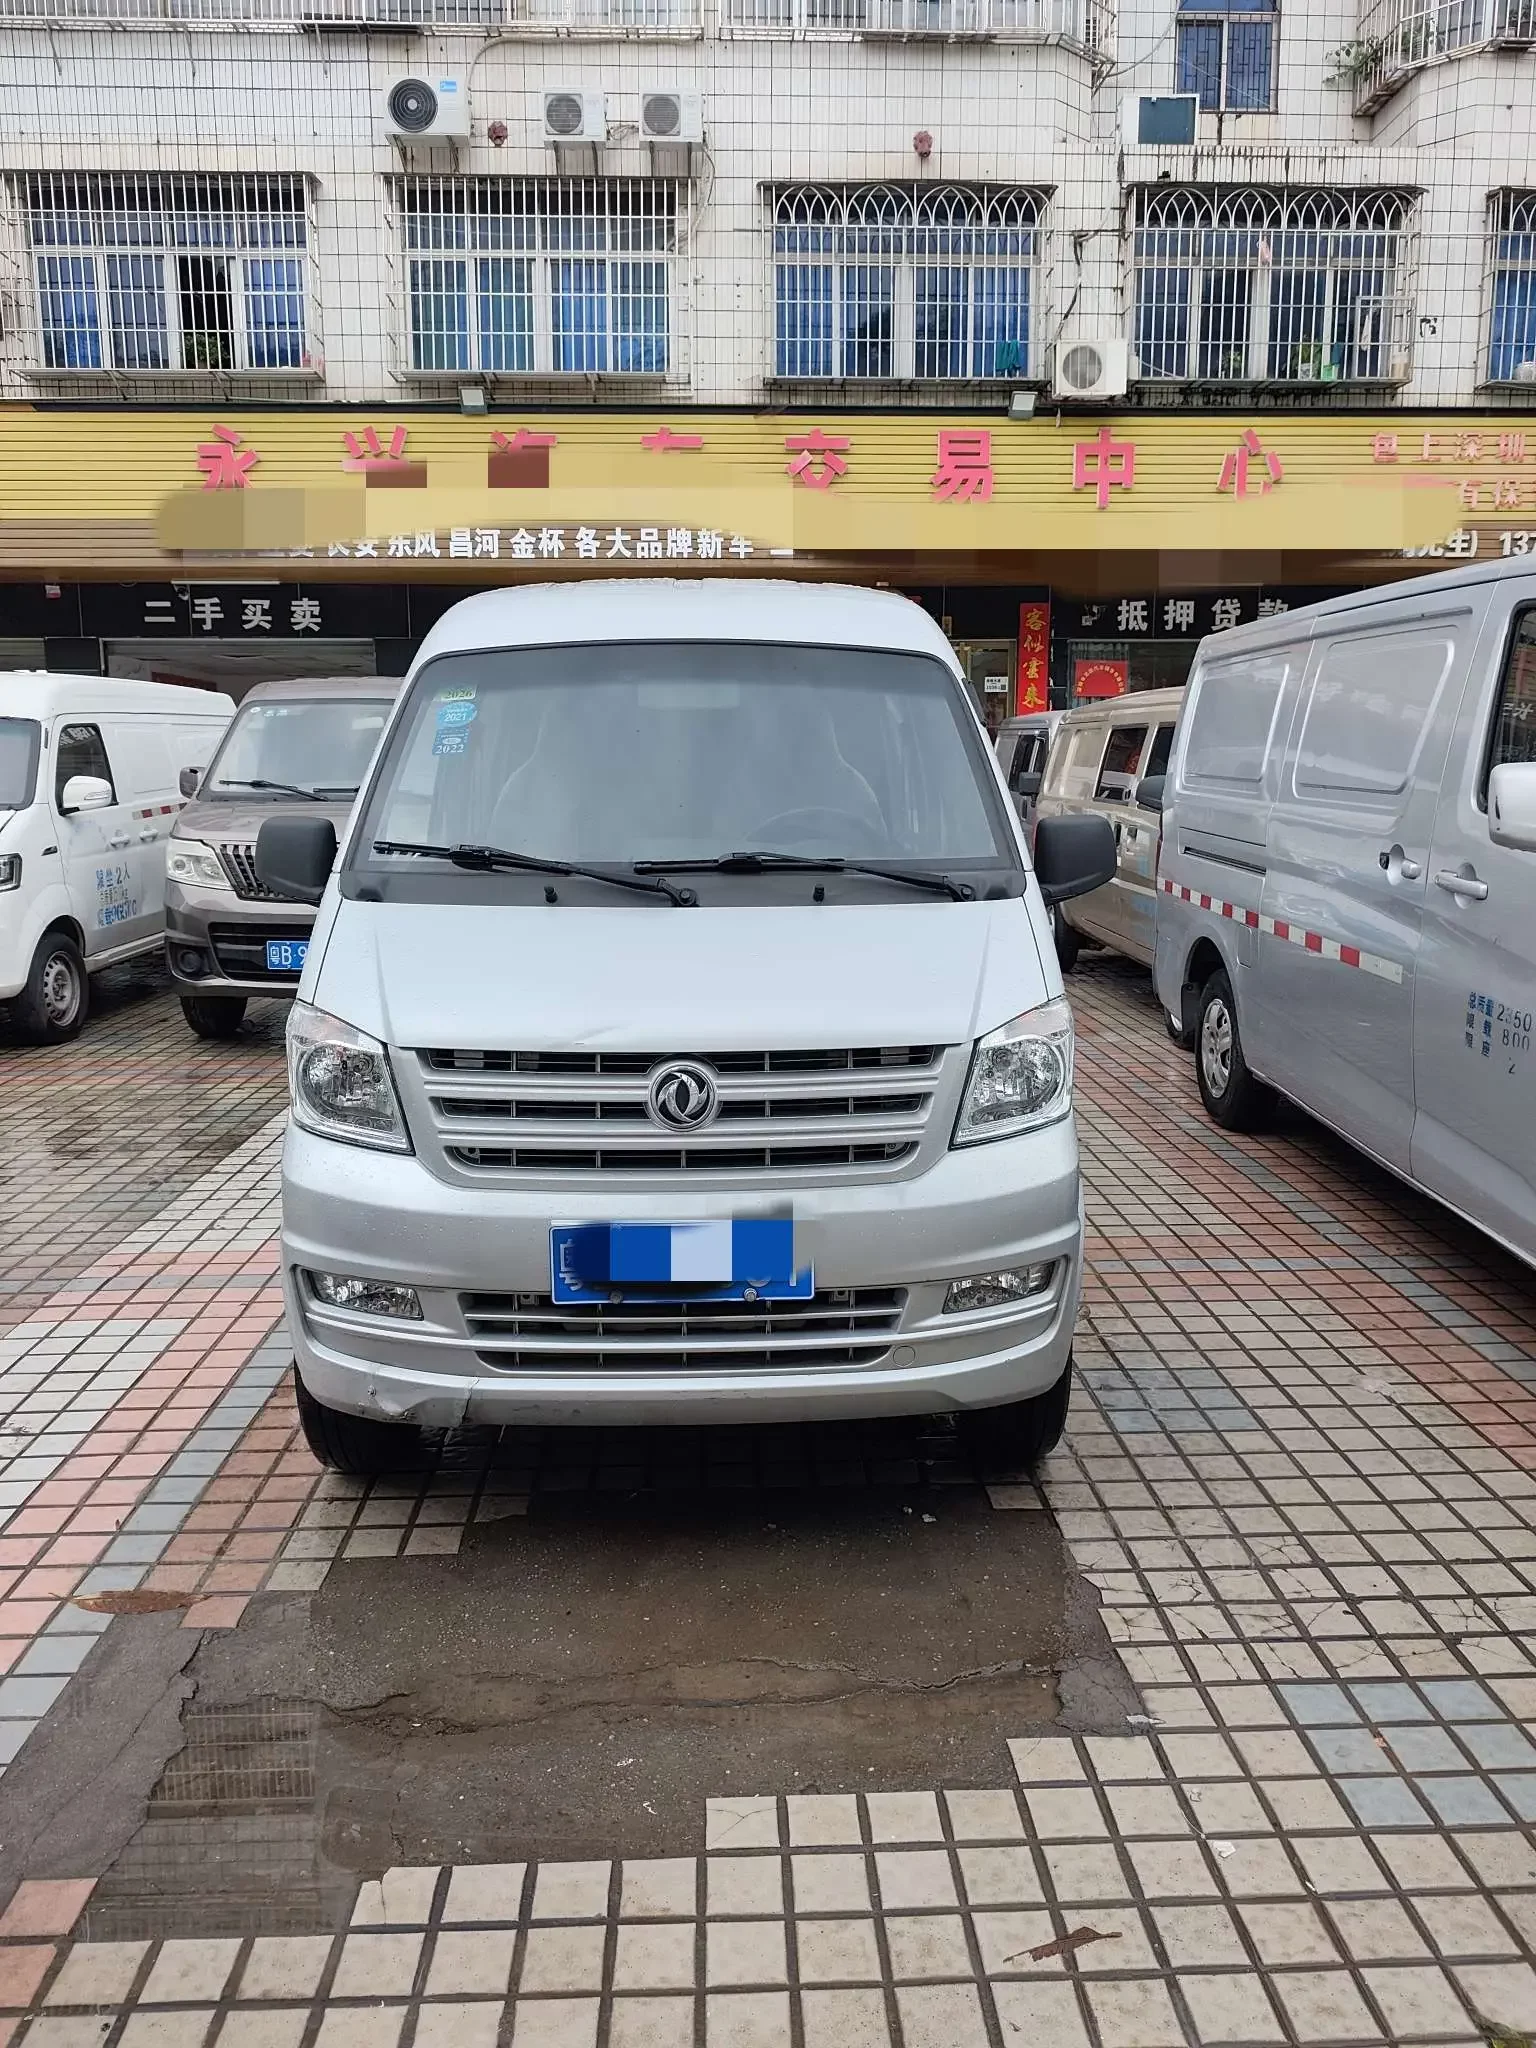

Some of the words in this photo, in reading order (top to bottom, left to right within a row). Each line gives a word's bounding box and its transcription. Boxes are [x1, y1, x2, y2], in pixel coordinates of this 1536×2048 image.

[1453, 480, 1536, 509] 有保
[387, 528, 440, 557] 东风
[449, 527, 501, 558] 昌河
[510, 527, 565, 558] 金杯
[575, 527, 755, 558] 各大品牌新车
[144, 597, 322, 632] 二手买卖
[443, 712, 467, 722] 2021
[435, 744, 465, 754] 2022
